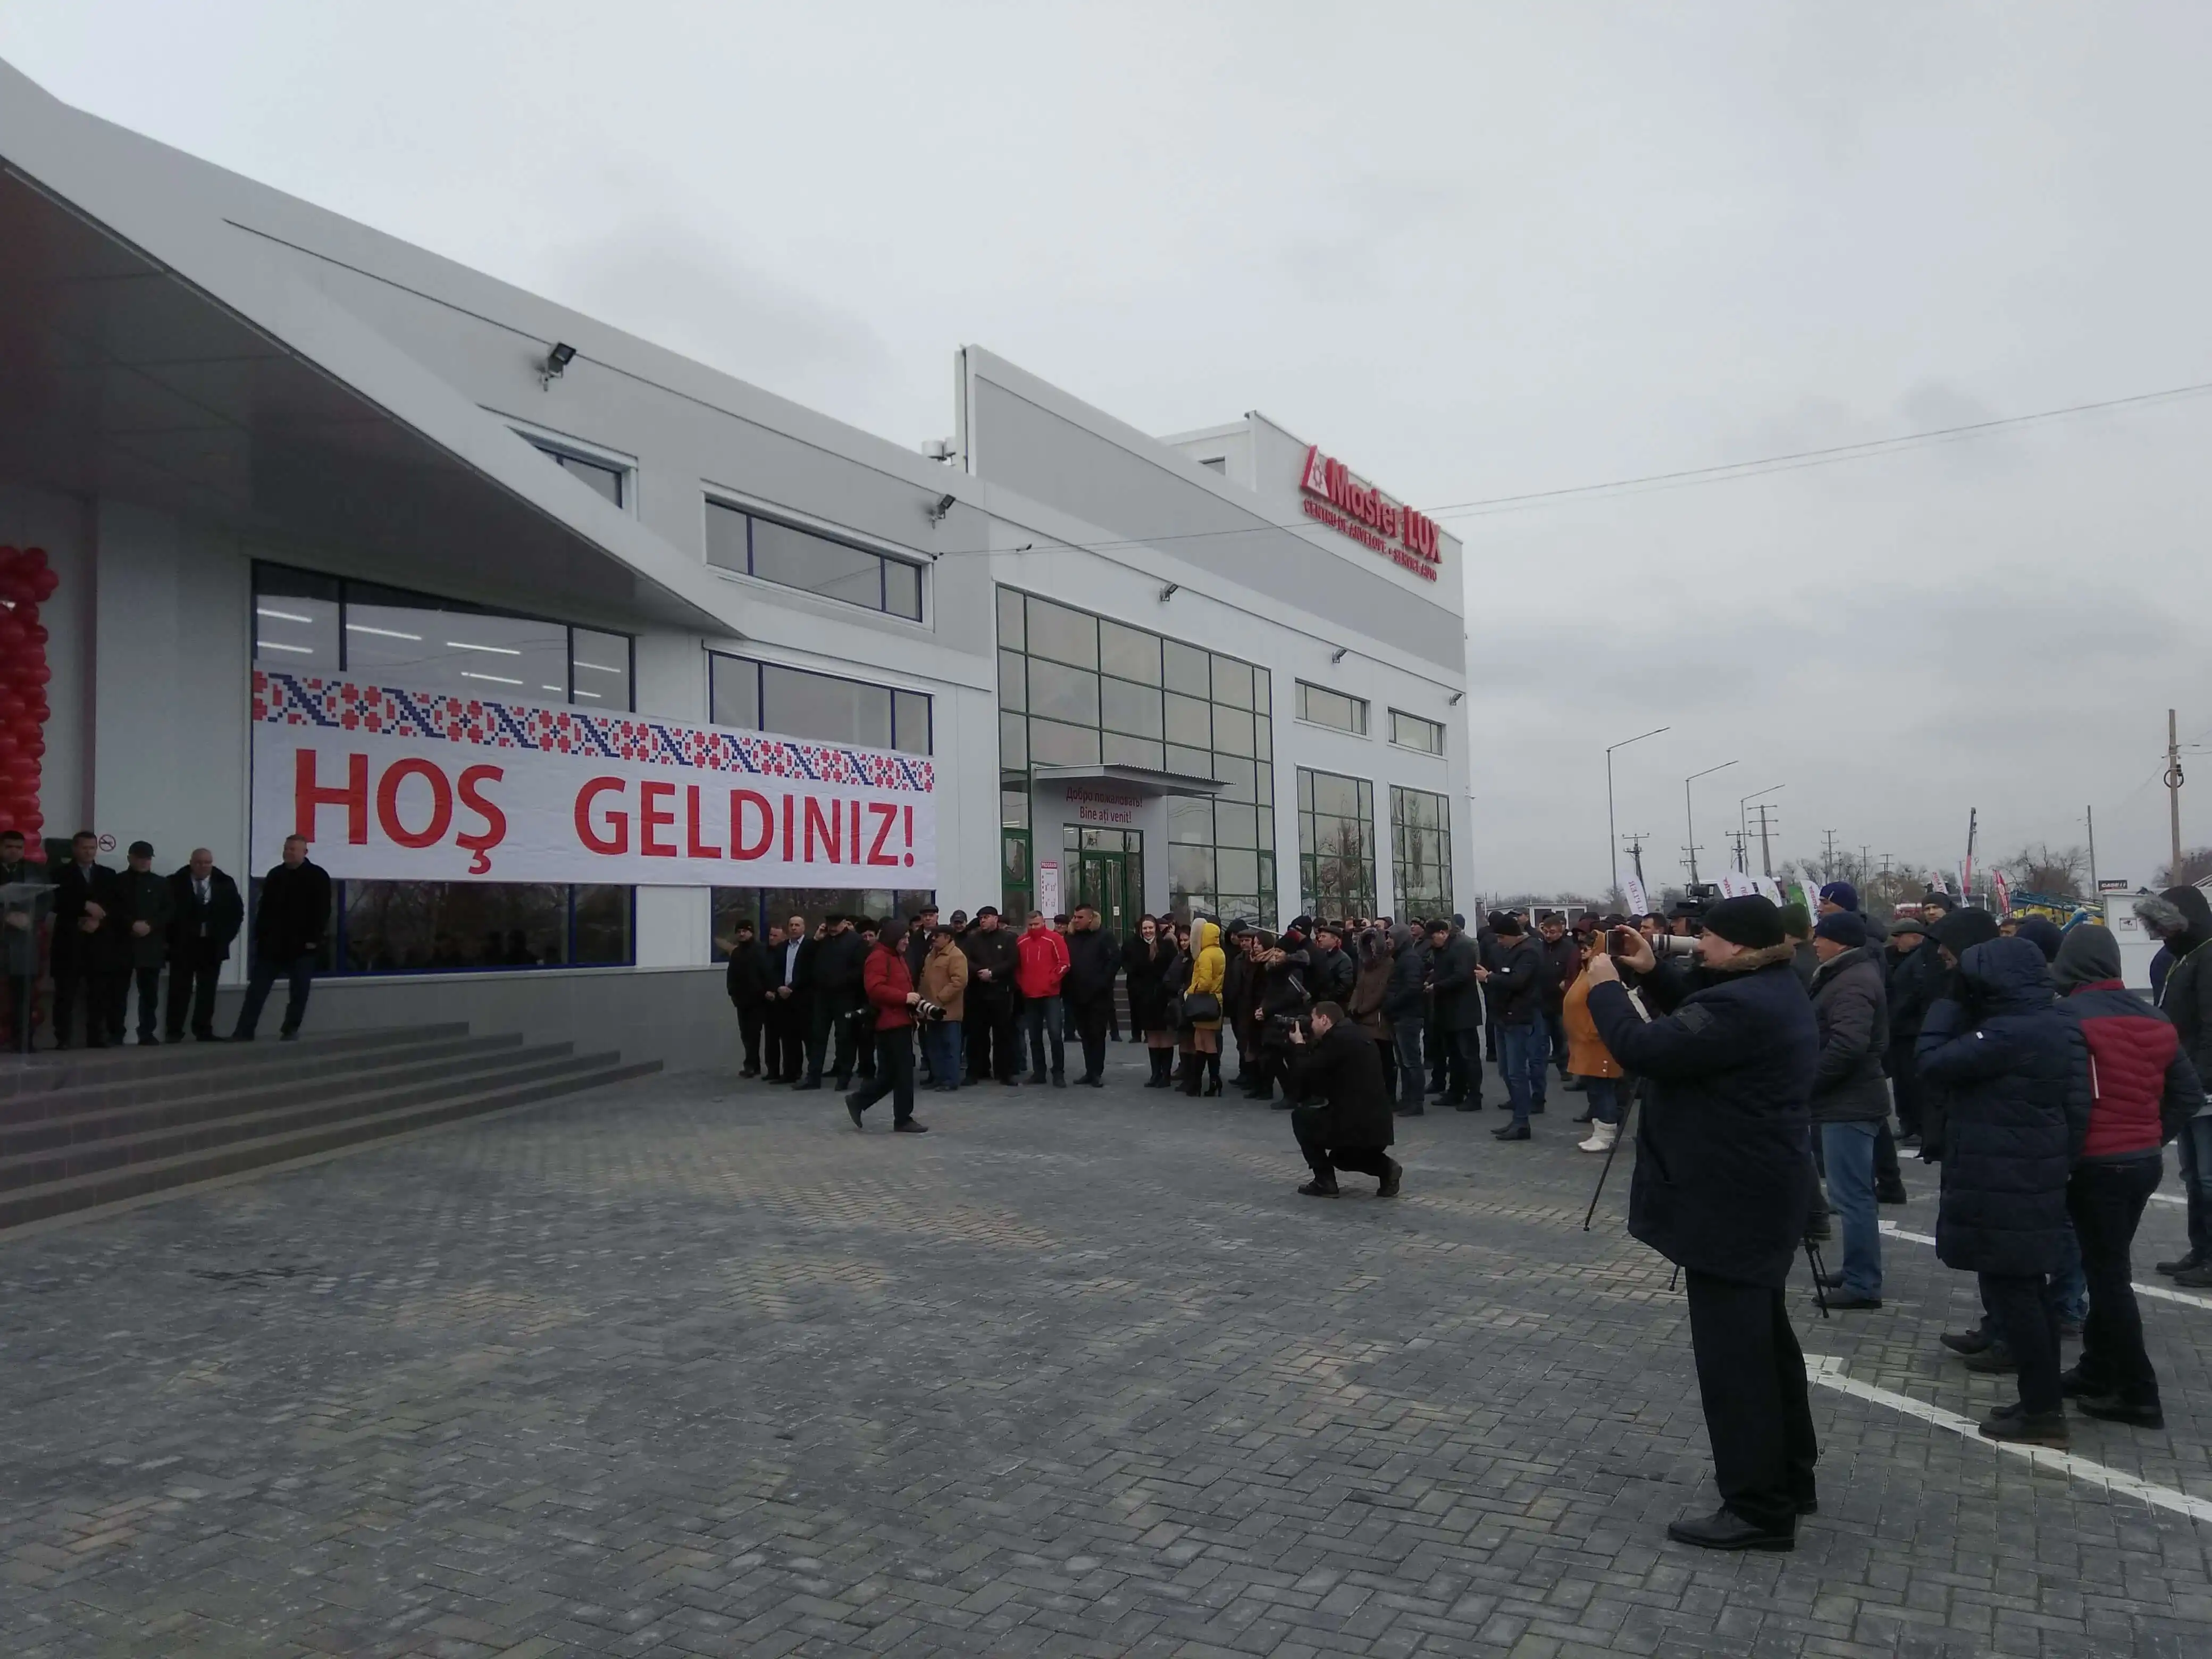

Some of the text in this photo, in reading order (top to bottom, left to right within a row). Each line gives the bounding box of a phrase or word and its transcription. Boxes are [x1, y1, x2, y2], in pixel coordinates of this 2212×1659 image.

[1326, 457, 1442, 564] Master LUX
[295, 749, 914, 874] HOŞ GELDINIZ!
[1066, 786, 1142, 808] Добро пожаловать!
[1080, 806, 1097, 820] Bine
[1110, 811, 1132, 824] venit!
